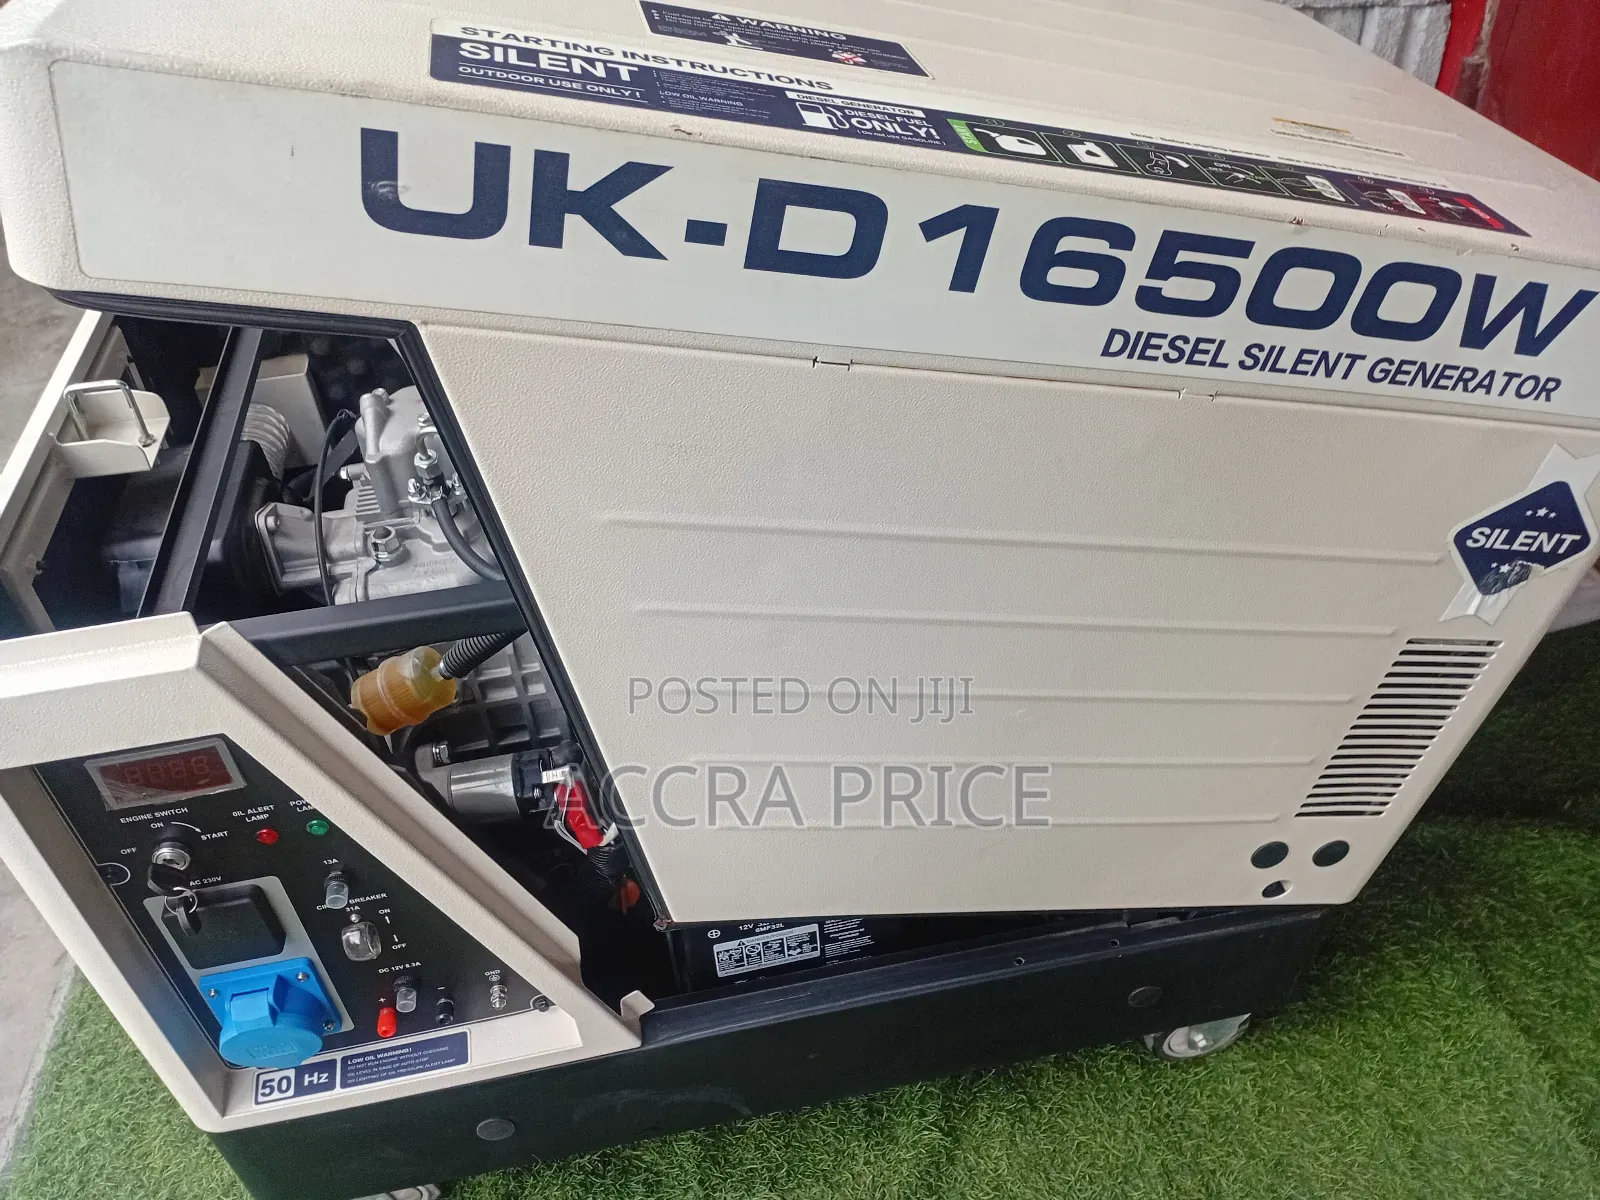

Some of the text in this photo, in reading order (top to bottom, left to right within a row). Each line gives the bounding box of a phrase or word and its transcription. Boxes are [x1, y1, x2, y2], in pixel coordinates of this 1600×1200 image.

[736, 16, 847, 40] WARNING
[458, 42, 639, 82] SILENT
[461, 27, 614, 56] STARTING
[621, 50, 834, 91] INSTRUCTIONS
[458, 66, 545, 85] OUTDOOR
[549, 78, 582, 90] USE
[659, 90, 744, 107] LOW OIL WARNING
[796, 94, 915, 115] DIESEL GENERATOR
[844, 109, 933, 127] DIESEL FUEL
[851, 117, 941, 140] ONLY!
[1100, 327, 1562, 403] DIESEL SILENT GENERATOR
[1465, 526, 1582, 555] SILENT
[119, 807, 189, 824] ENGINE SWITCH
[247, 804, 275, 815] ALERT
[150, 821, 164, 829] ON
[245, 813, 270, 823] LAMP
[200, 830, 229, 841] START
[120, 847, 137, 855] OFF
[323, 858, 339, 866] 13A
[189, 875, 222, 887] AC 230V
[349, 892, 388, 904] BREAKER
[738, 923, 754, 931] 12V
[392, 942, 407, 950] OFF
[391, 964, 404, 972] 12V
[484, 969, 501, 977] GND
[400, 1052, 422, 1060] WITHOUT
[423, 1046, 448, 1054] CHECKING
[260, 1071, 329, 1098] 50 Hz
